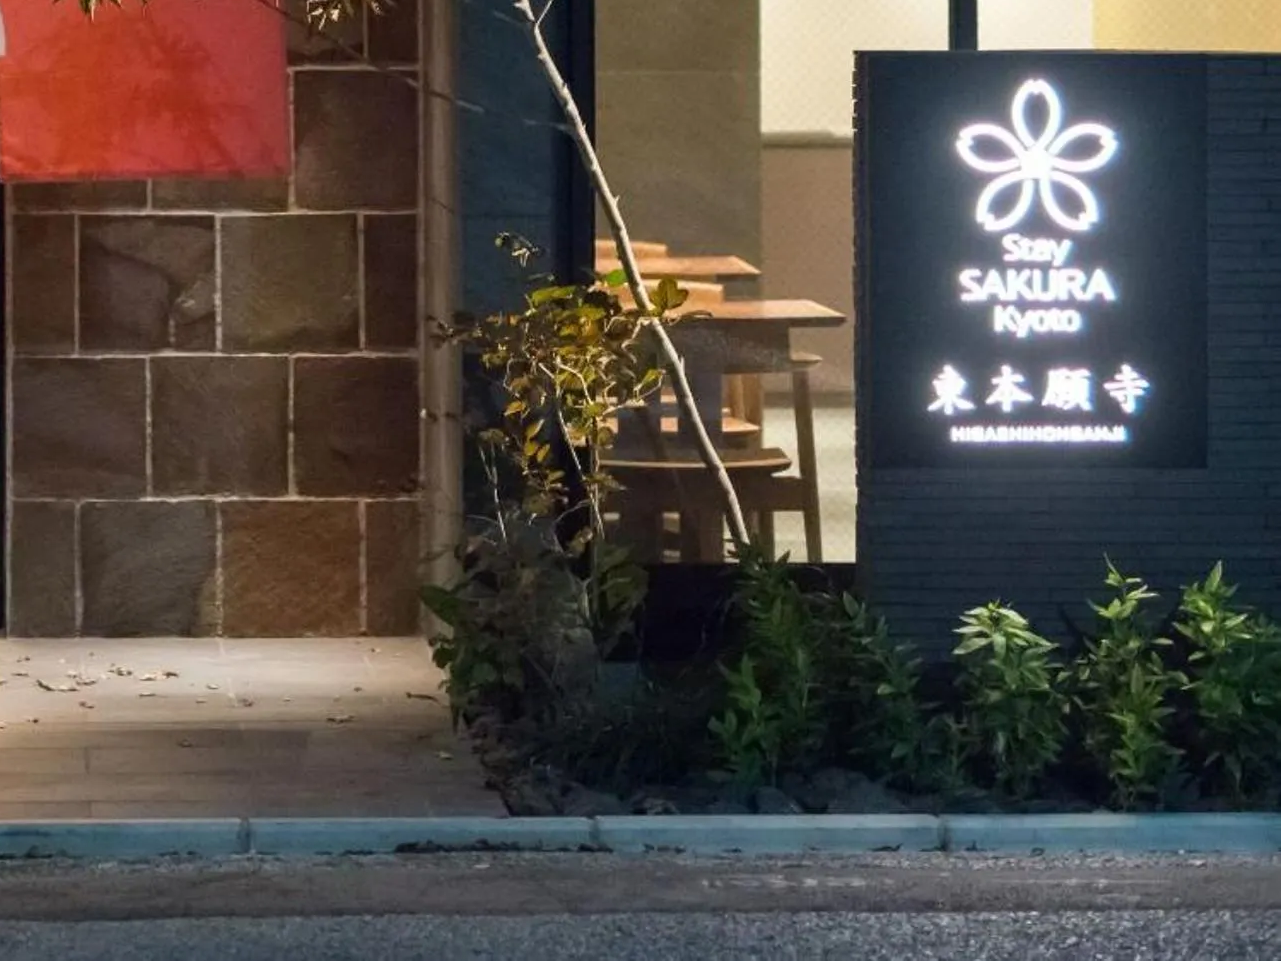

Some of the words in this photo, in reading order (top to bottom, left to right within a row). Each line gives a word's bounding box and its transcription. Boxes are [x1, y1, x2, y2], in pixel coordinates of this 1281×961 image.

[1002, 233, 1072, 266] Stay
[958, 268, 1116, 301] SAKURA
[994, 304, 1081, 338] Kyoto
[927, 364, 1149, 414] 東本願寺
